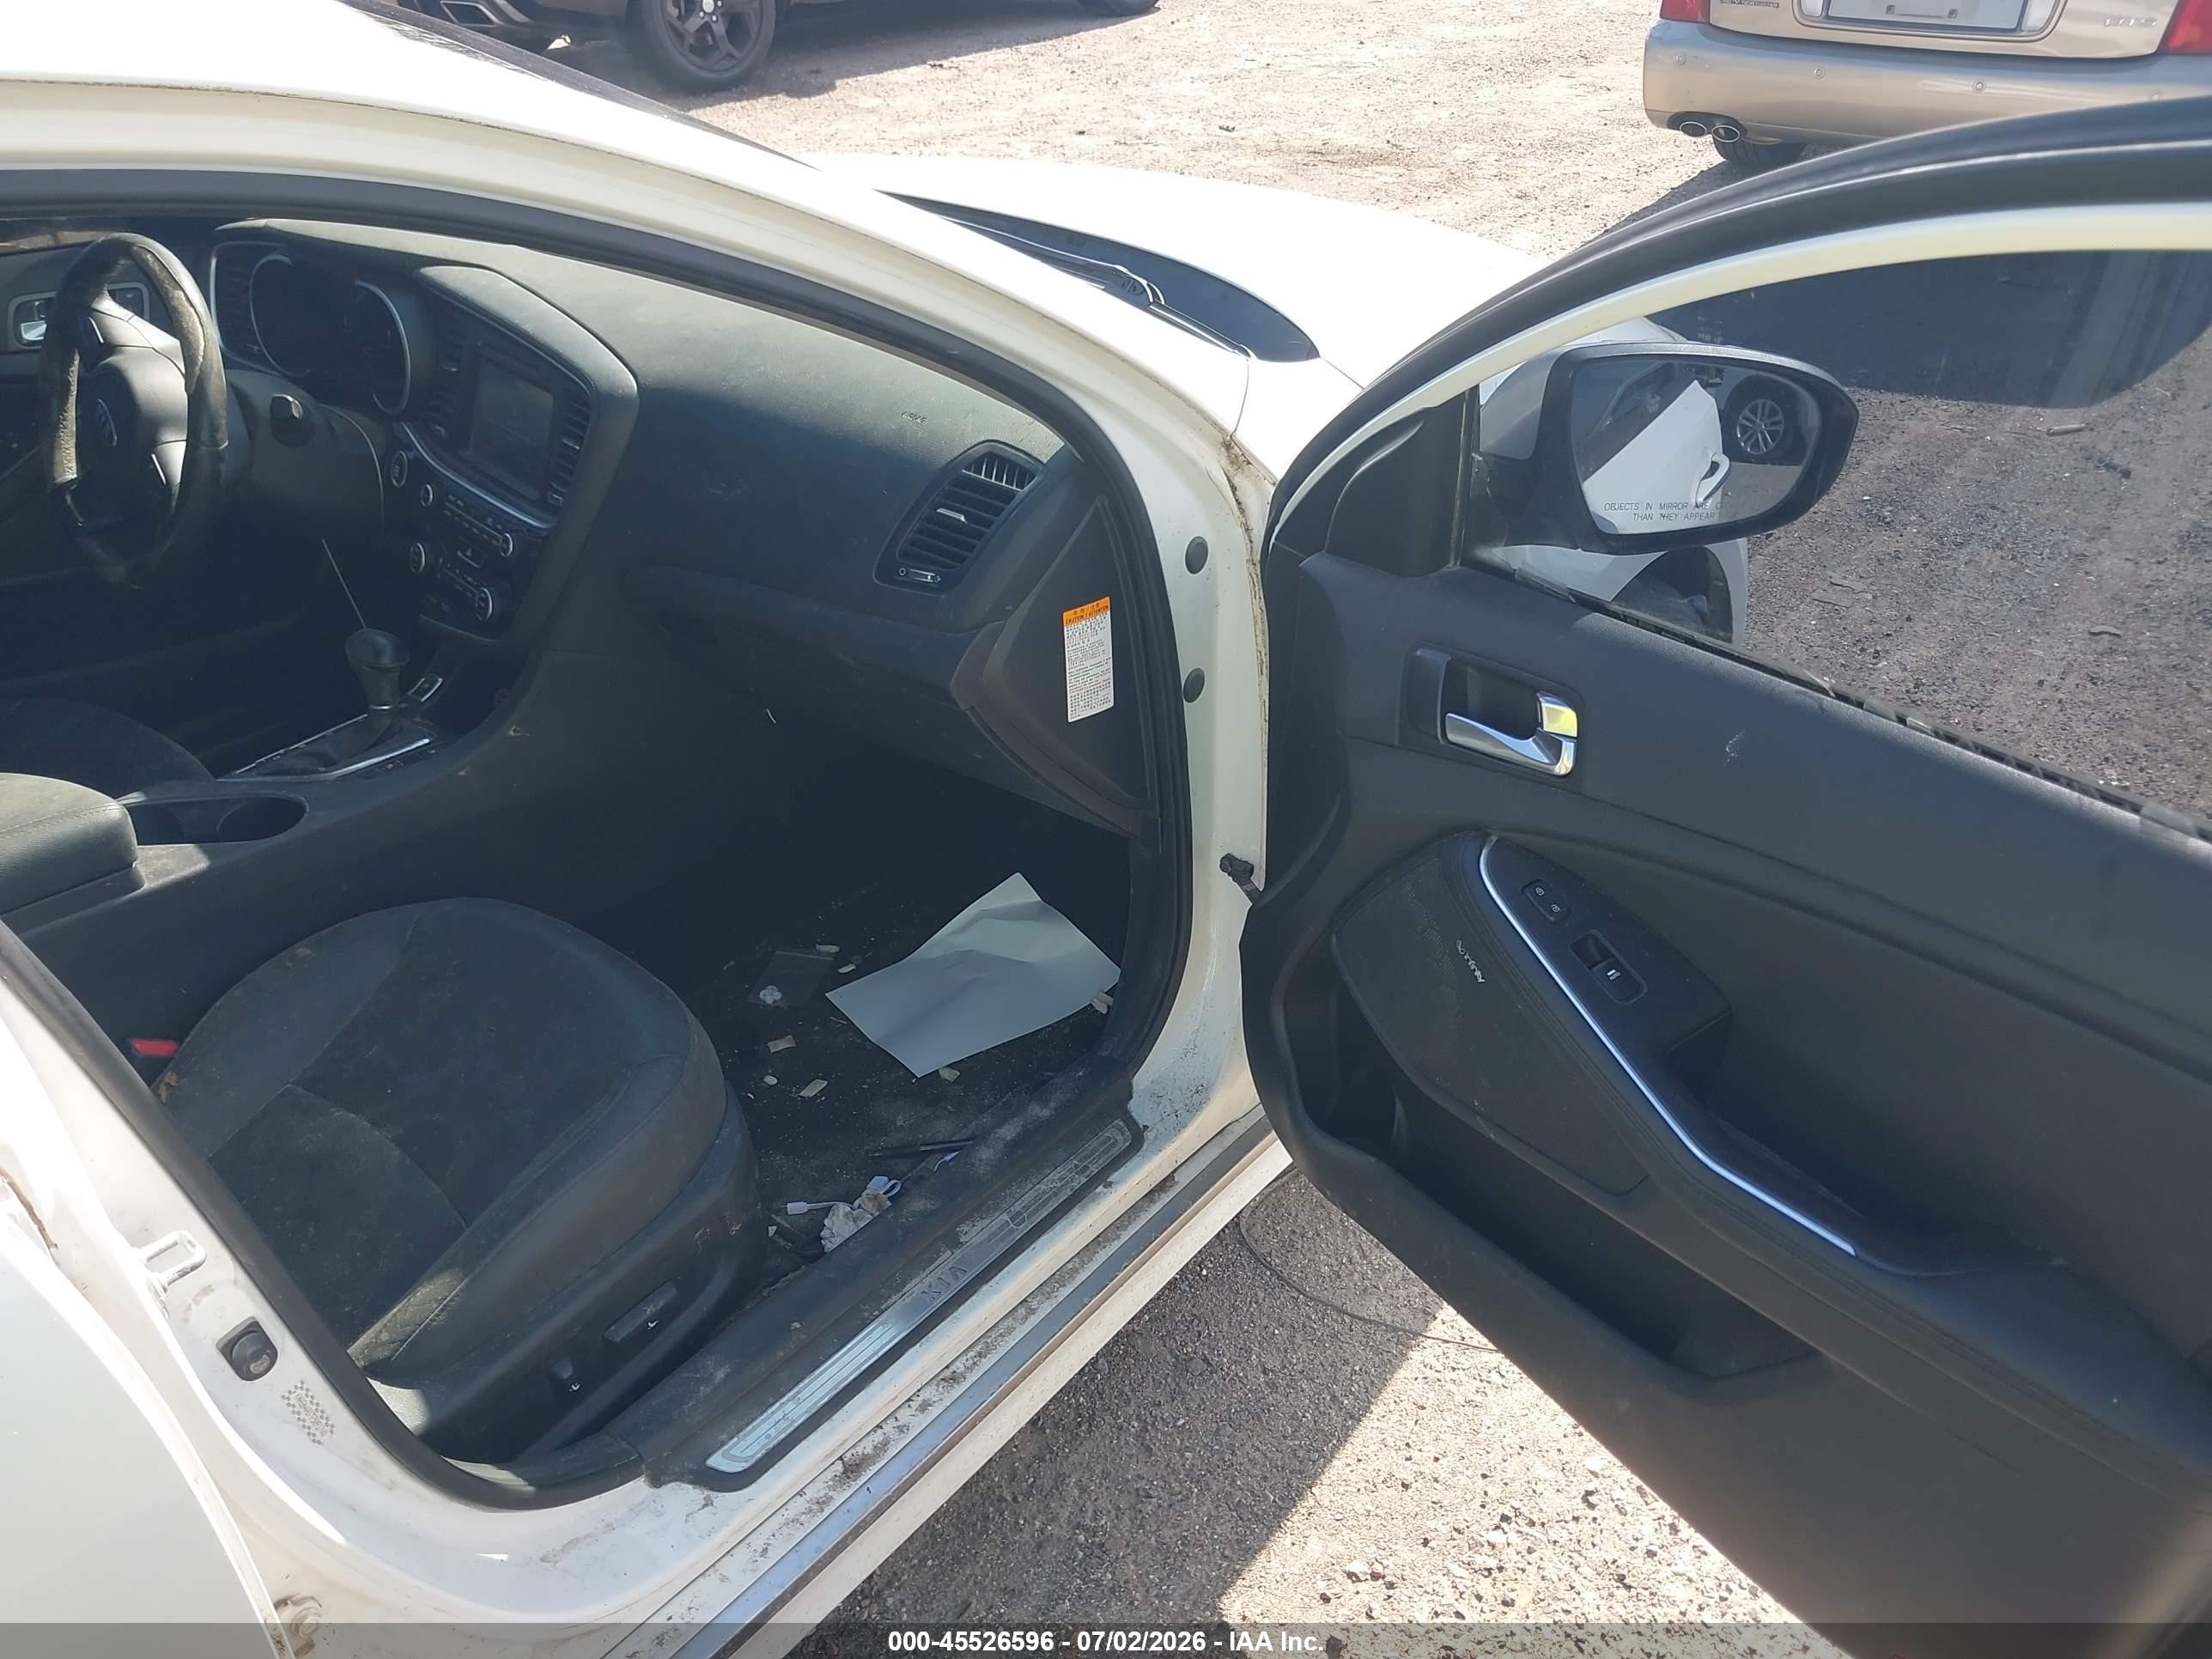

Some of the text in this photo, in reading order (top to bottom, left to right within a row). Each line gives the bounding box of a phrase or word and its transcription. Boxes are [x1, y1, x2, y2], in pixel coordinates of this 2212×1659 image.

[1604, 502, 1639, 511] OBJECTS
[1645, 502, 1653, 511] IN
[1659, 501, 1689, 510] MIRROR
[1693, 501, 1710, 510] ARE
[1633, 513, 1654, 521] THAN
[1659, 513, 1679, 521] THEY
